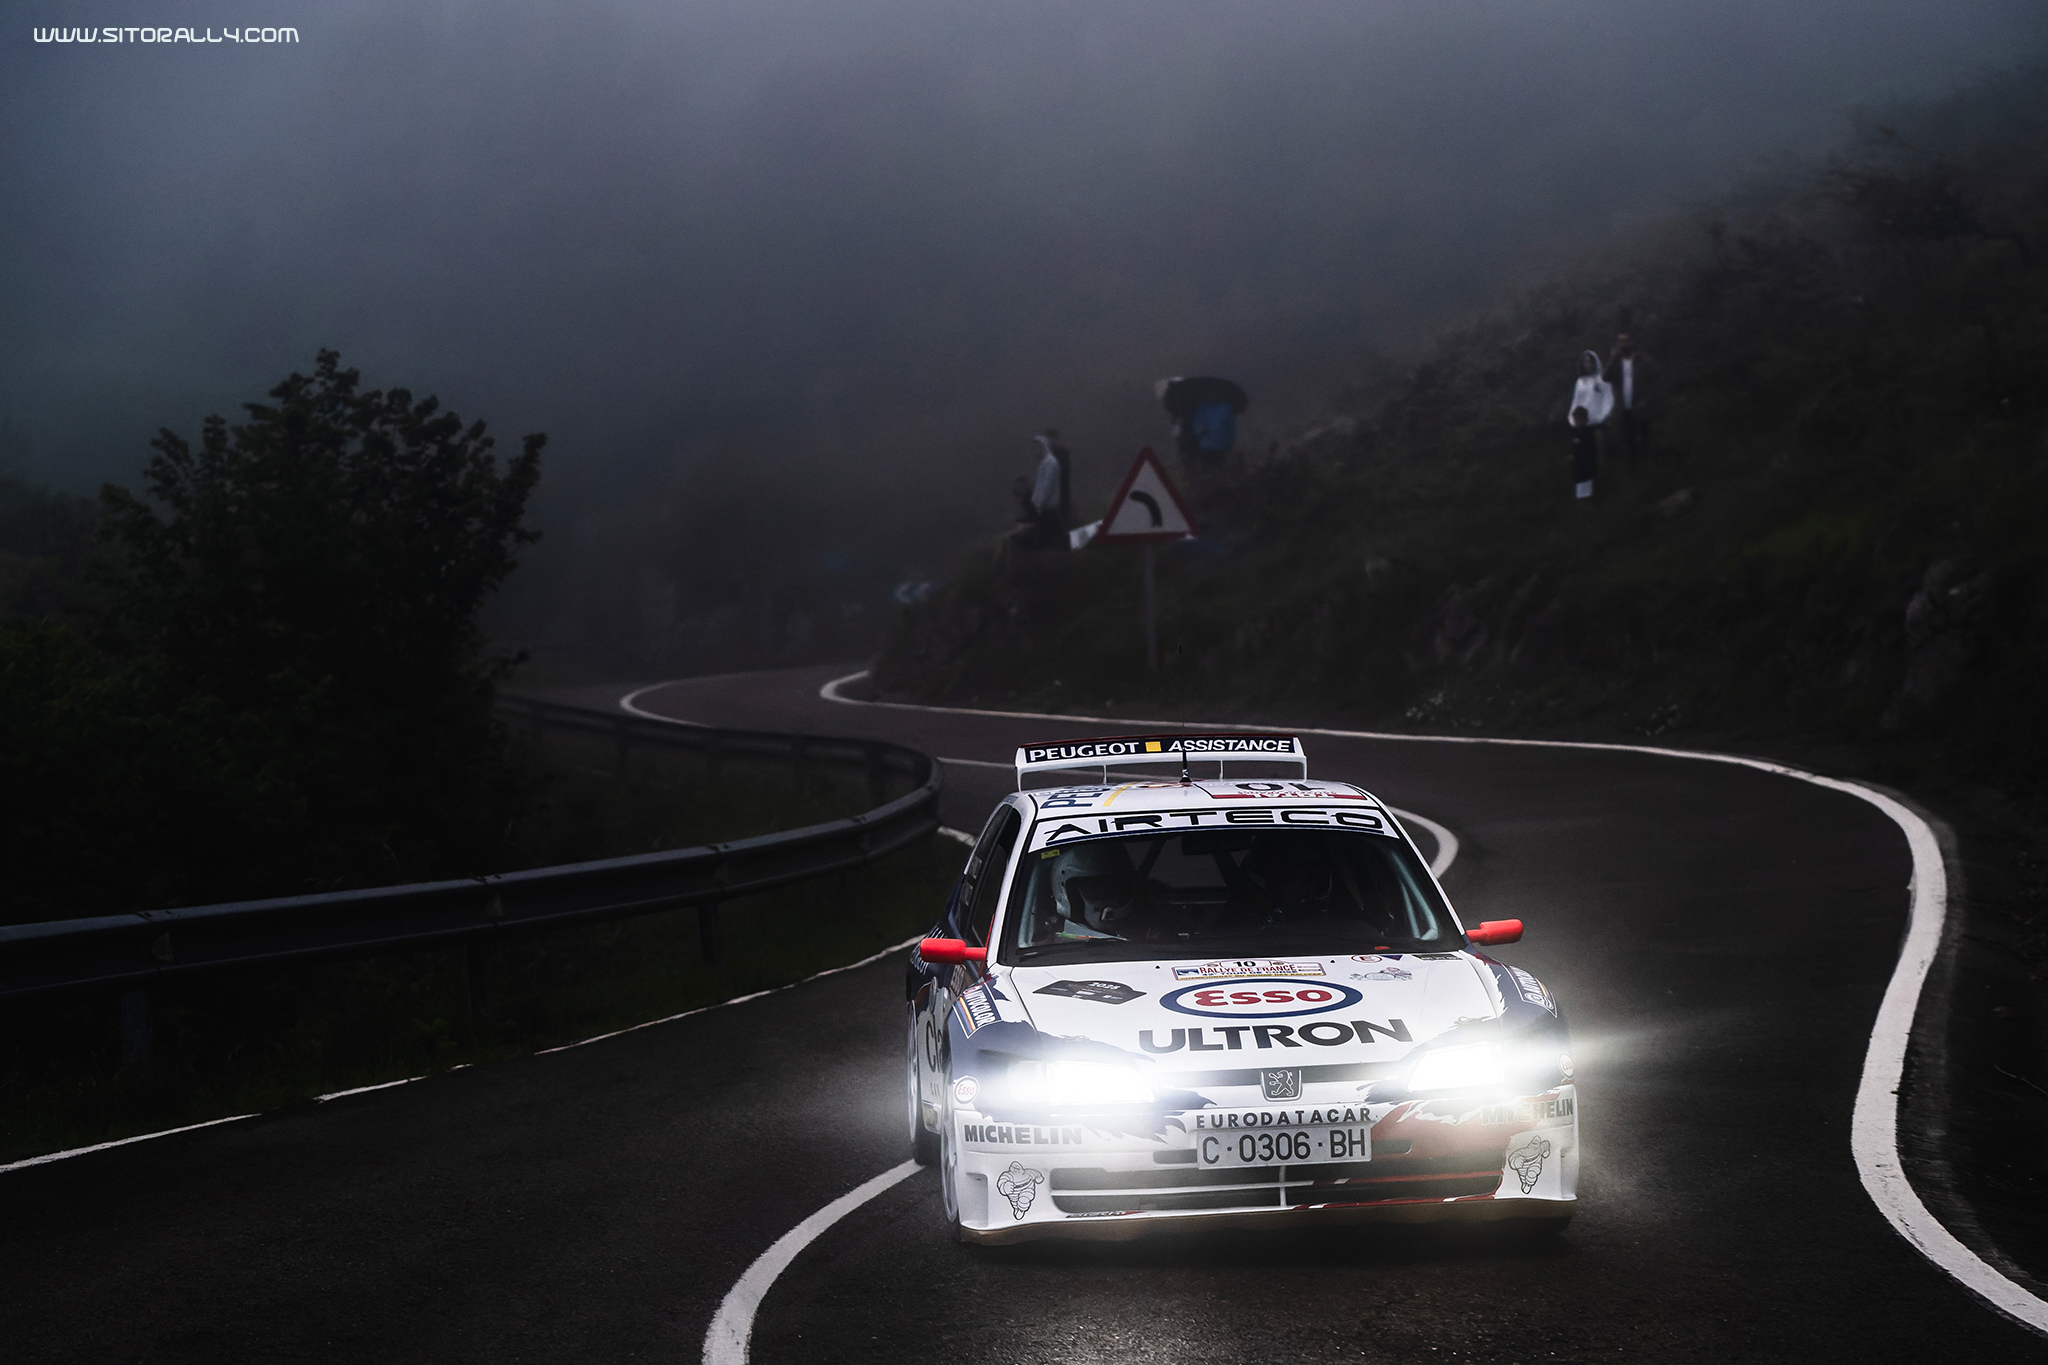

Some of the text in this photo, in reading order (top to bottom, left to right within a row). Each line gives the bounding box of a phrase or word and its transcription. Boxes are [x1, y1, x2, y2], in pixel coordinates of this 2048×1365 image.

[1030, 739, 1290, 761] PEUGEOT ASSISTANCE
[1044, 810, 1383, 842] AIRTECO
[1256, 964, 1295, 972] FRANCE
[1139, 1019, 1413, 1054] ULTRON
[1196, 1107, 1371, 1128] EURODATACAR
[1481, 1098, 1573, 1125] MICHELIN
[964, 1124, 1082, 1145] MICHELIN
